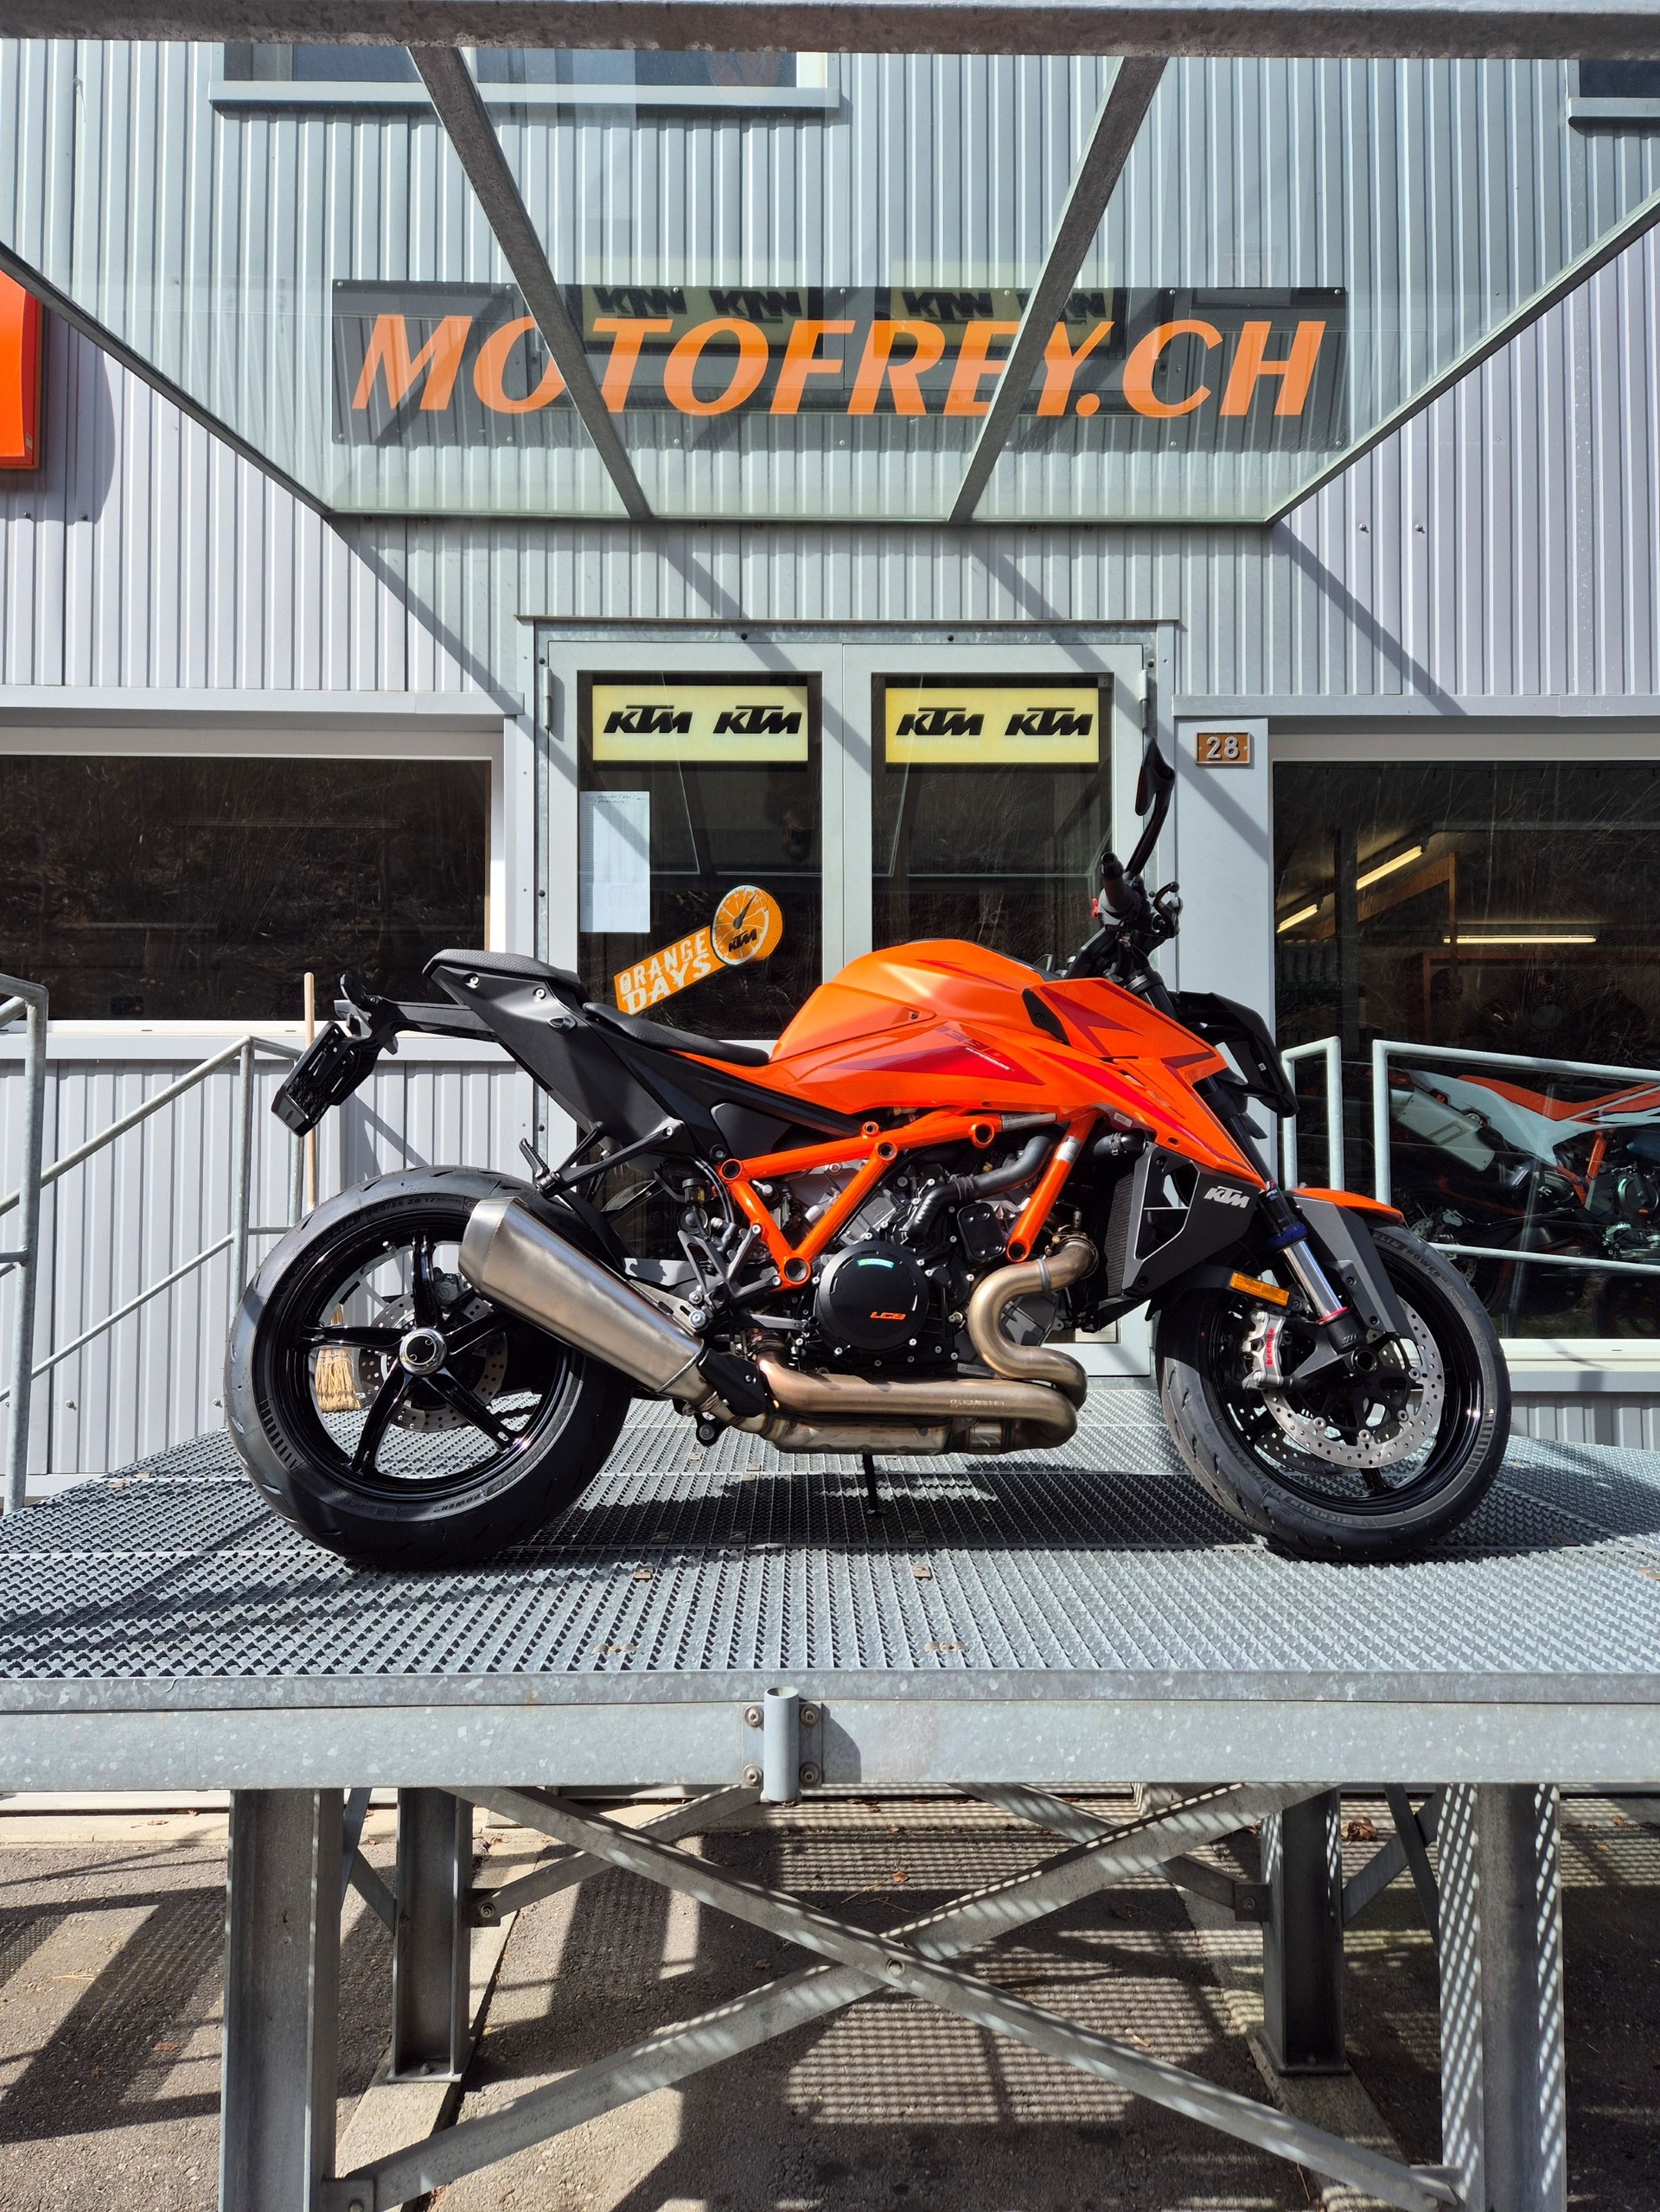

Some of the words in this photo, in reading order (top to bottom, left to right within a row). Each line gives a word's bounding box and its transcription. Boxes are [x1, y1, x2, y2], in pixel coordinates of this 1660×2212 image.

[351, 314, 1325, 418] MOTOFREY.CH
[603, 705, 693, 734] KTM
[713, 705, 802, 735] KTM
[896, 707, 985, 736] KTM
[1005, 707, 1094, 736] KTM
[1207, 736, 1238, 759] 28
[729, 928, 757, 953] KTM
[619, 930, 707, 995] ORANGE
[622, 953, 712, 1015] DAYS
[1204, 1186, 1250, 1208] KTM
[1265, 1328, 1275, 1367] brembo
